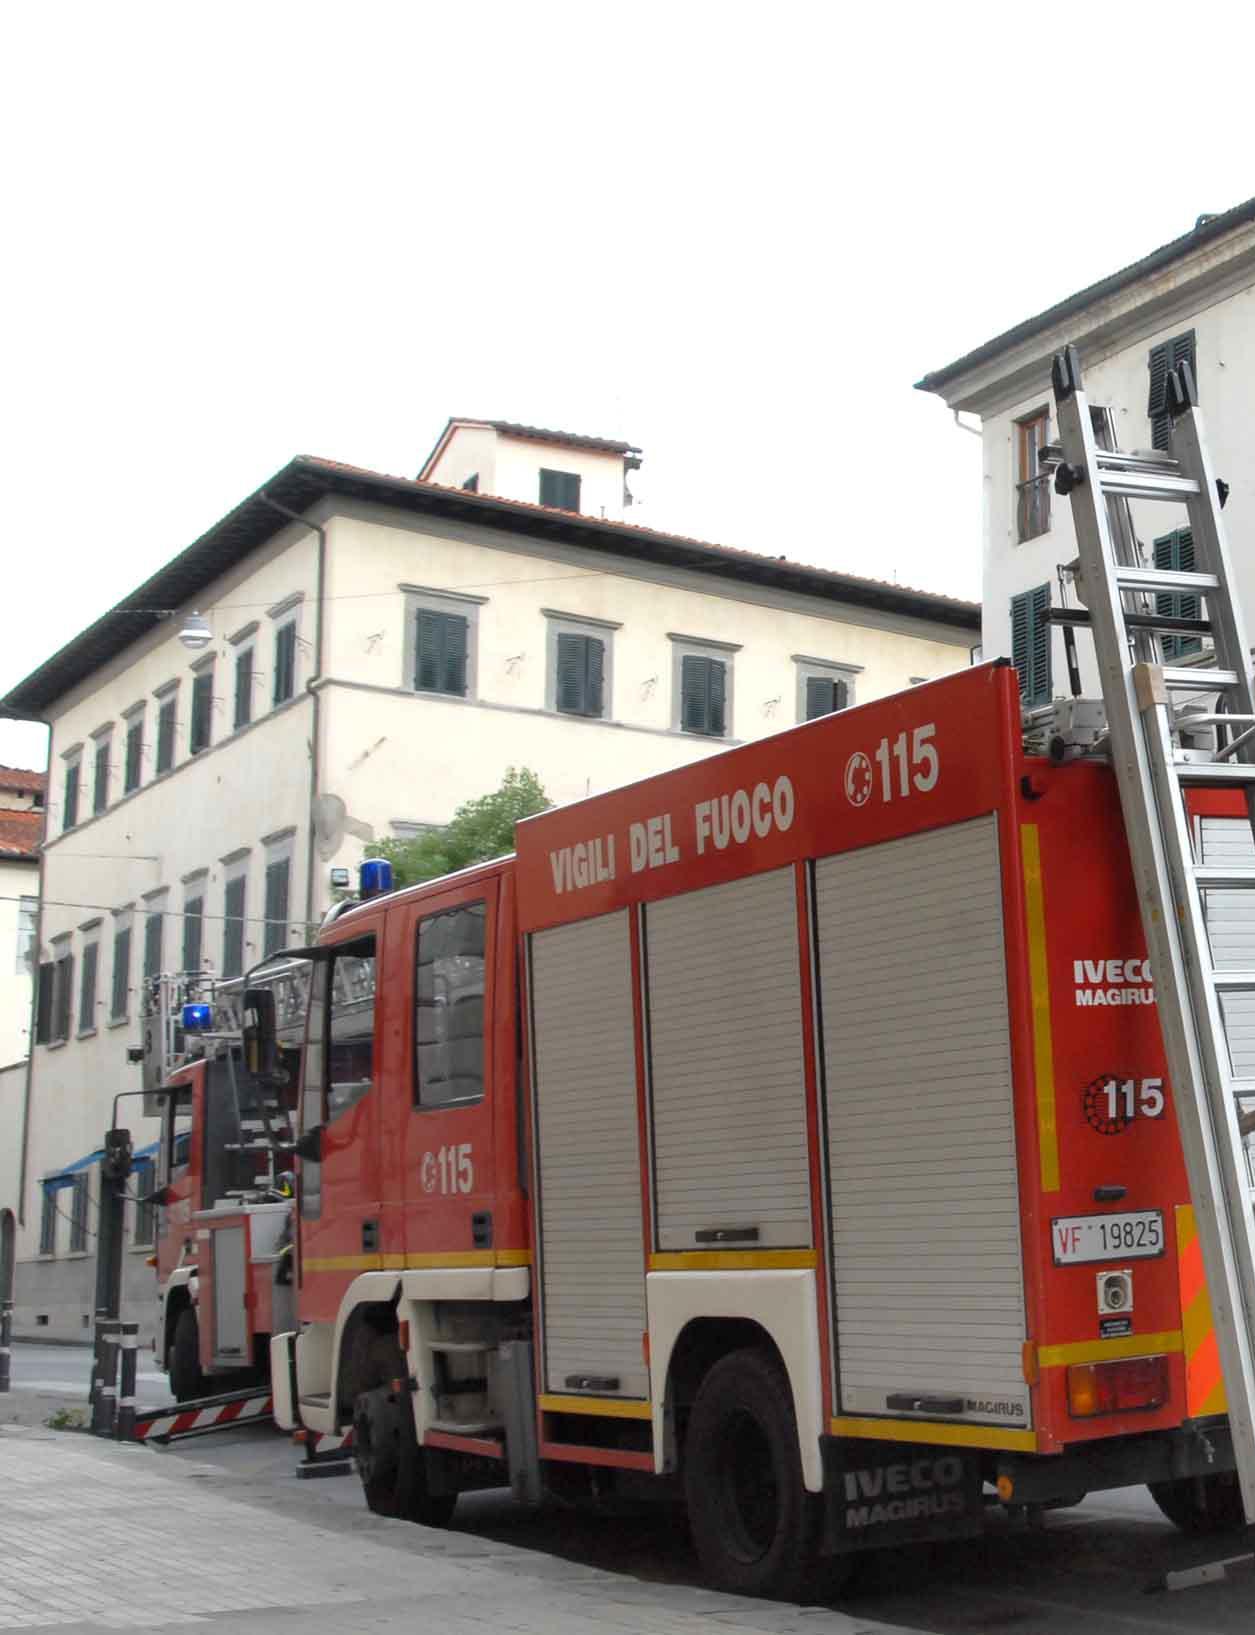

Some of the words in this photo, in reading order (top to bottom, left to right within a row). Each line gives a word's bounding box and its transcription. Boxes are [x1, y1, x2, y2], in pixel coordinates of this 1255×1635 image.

[875, 722, 941, 802] 115
[550, 833, 617, 894] VIGILI
[629, 814, 680, 873] DEL
[695, 775, 795, 855] FUOCO
[1075, 988, 1157, 1006] MAGIRU
[1102, 1077, 1165, 1118] 115
[438, 1143, 474, 1195] 115
[1058, 1226, 1083, 1255] VF
[1099, 1219, 1160, 1251] 19825
[844, 1457, 963, 1502] IVECO
[846, 1490, 963, 1528] MAGIRUS
